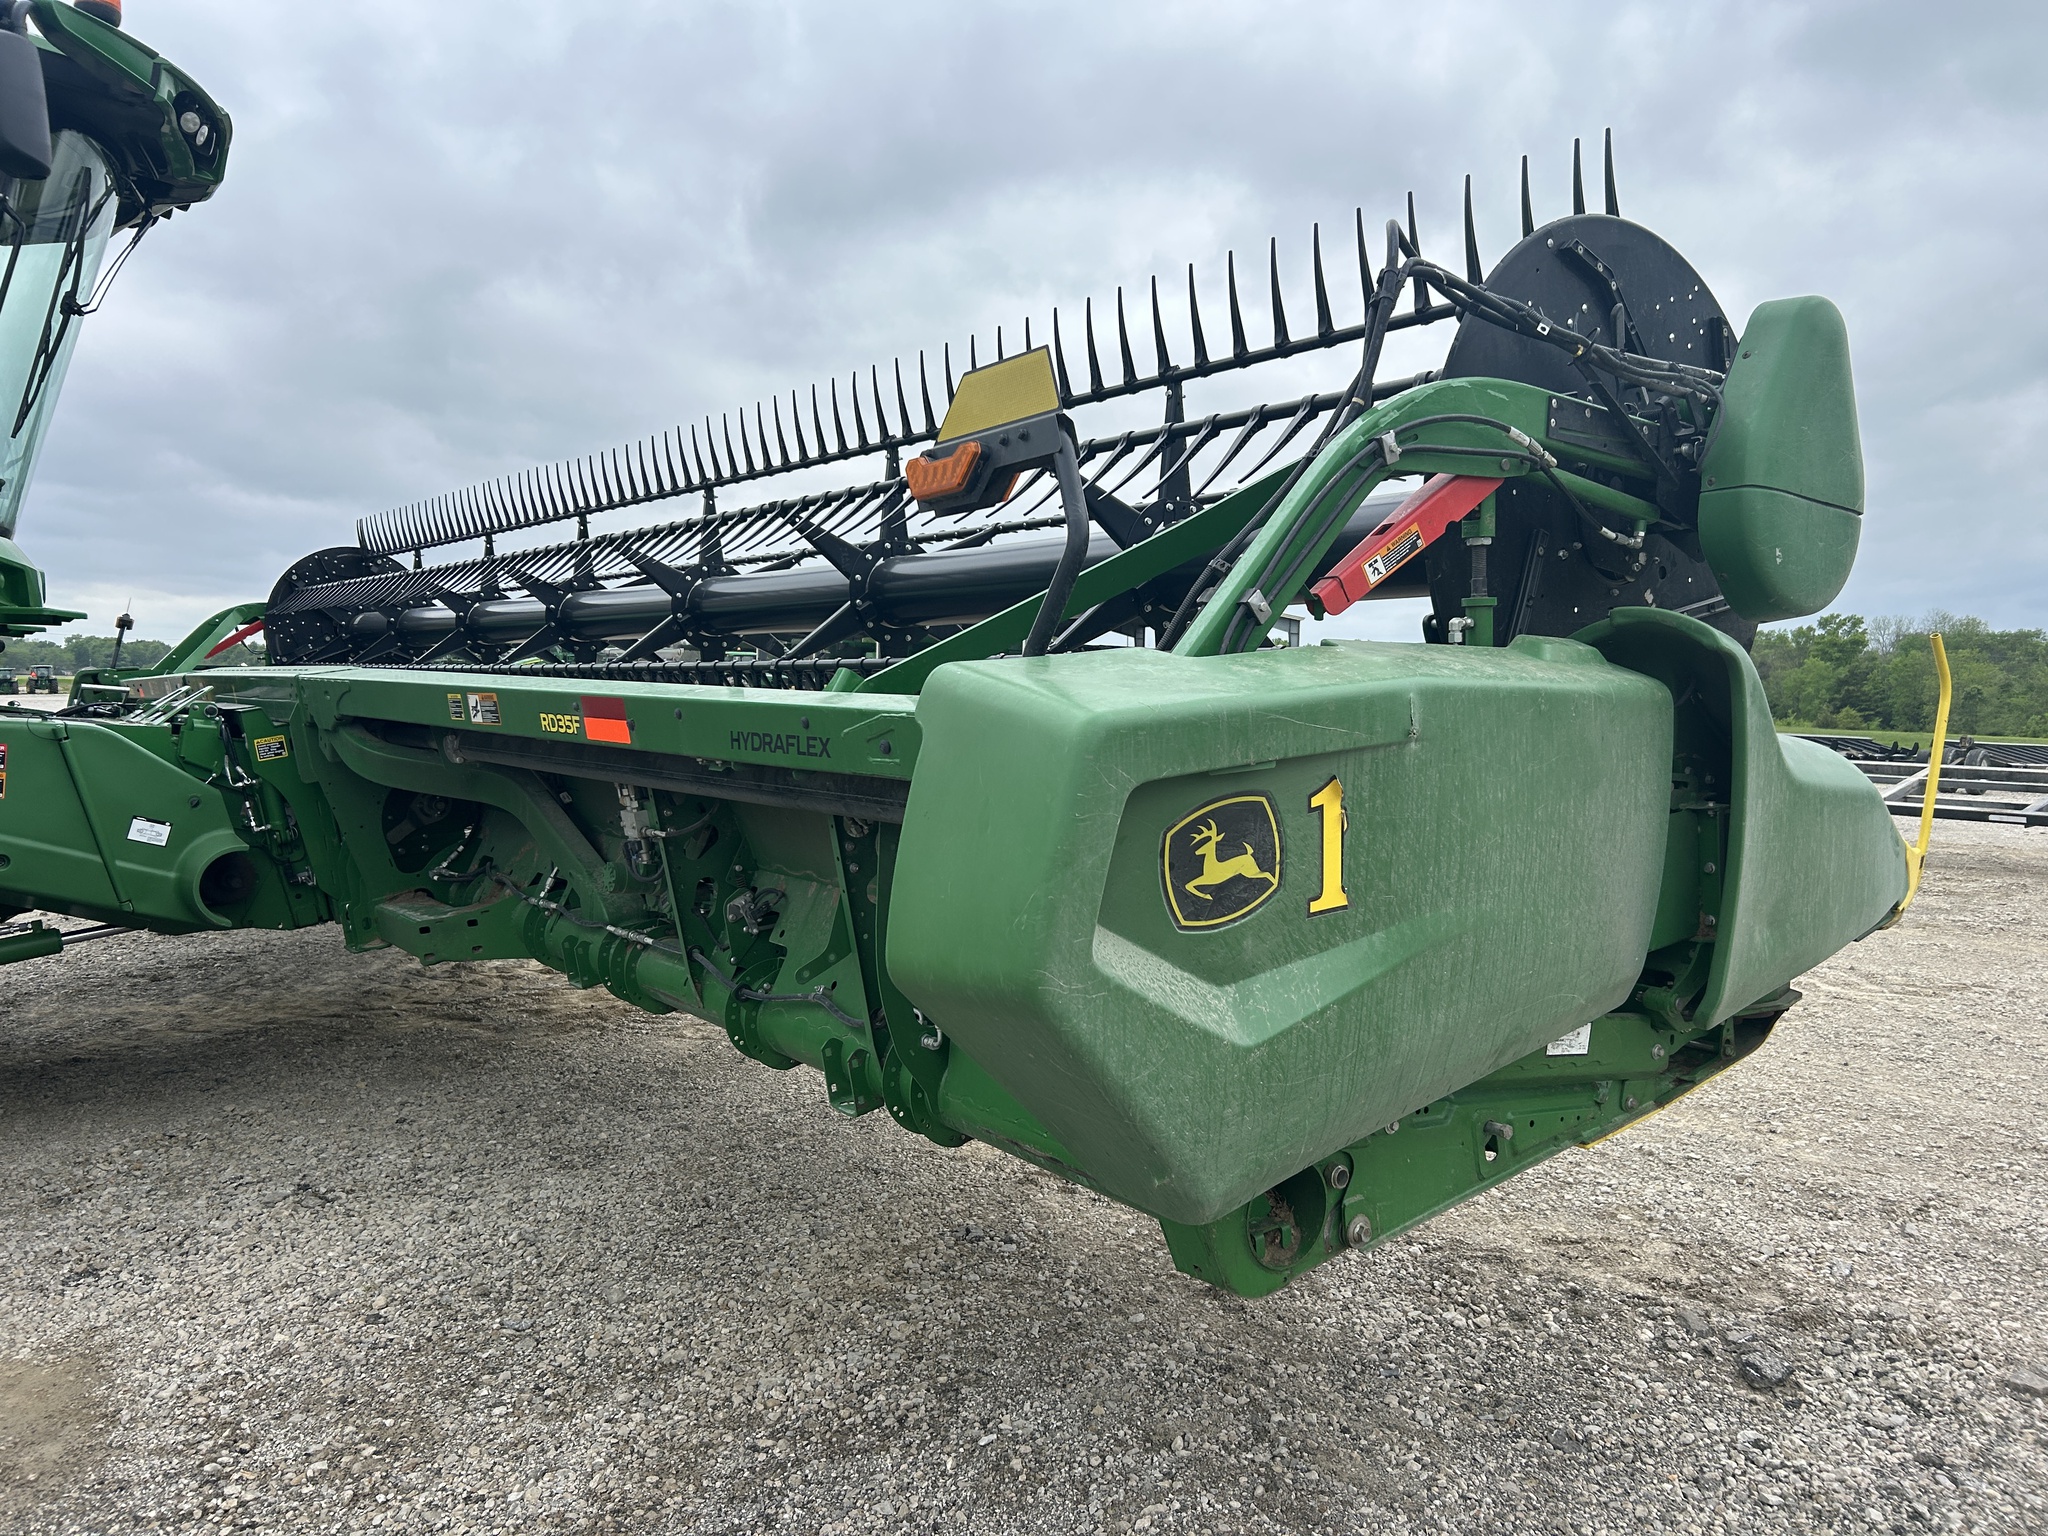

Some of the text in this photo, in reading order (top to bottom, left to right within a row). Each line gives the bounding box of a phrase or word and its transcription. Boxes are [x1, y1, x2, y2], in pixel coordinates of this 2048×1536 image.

[1390, 528, 1413, 548] WARNING
[539, 712, 581, 735] RD35F
[260, 736, 284, 744] CAUTION
[730, 730, 832, 759] HYDRAFLEX
[1308, 775, 1348, 918] 1
